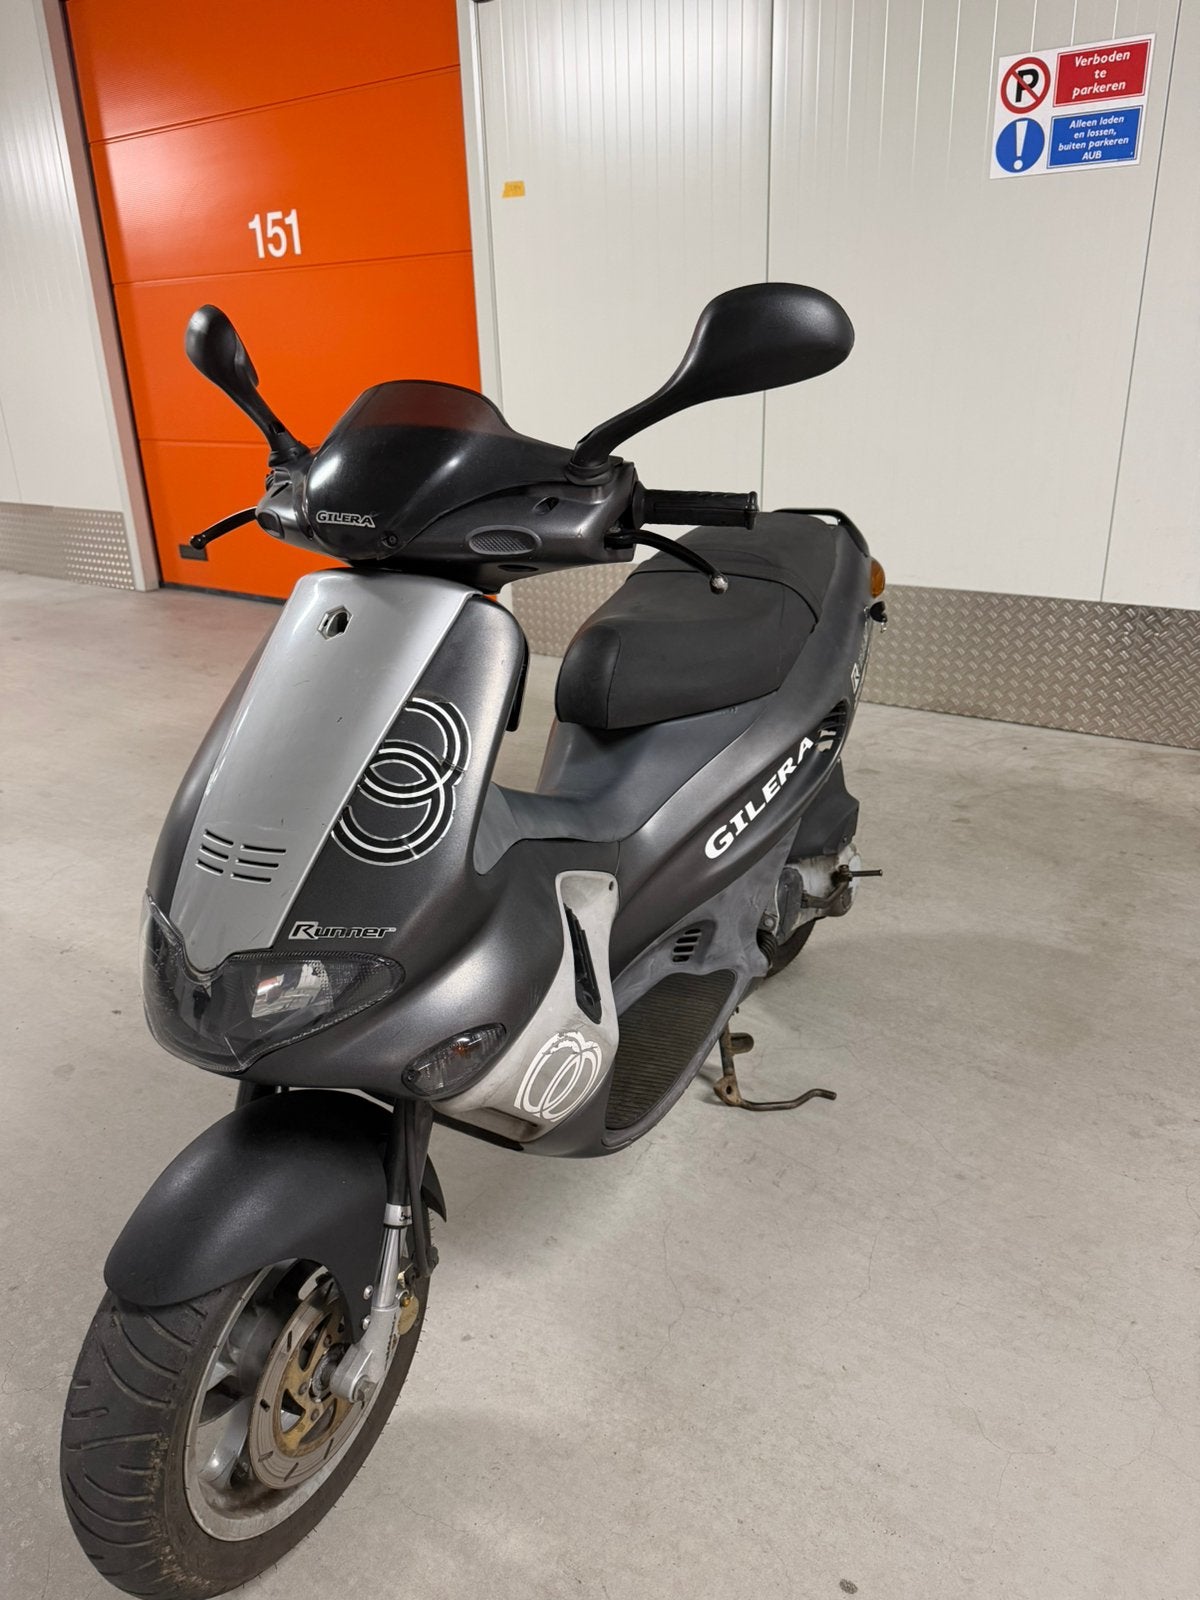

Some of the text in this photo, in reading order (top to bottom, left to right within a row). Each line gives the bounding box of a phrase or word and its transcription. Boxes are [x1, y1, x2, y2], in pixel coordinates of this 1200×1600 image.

[1074, 51, 1130, 67] Verboden
[1094, 69, 1107, 79] te
[1072, 81, 1126, 100] parkeren
[1069, 115, 1124, 129] Alleen laden
[1073, 127, 1117, 139] en lossen,
[1058, 136, 1129, 151] buiten parkeren
[1081, 150, 1102, 160] AUB
[248, 209, 301, 259] 151
[316, 510, 376, 528] GILERA
[705, 737, 814, 859] GILERA
[288, 921, 397, 940] Runner
